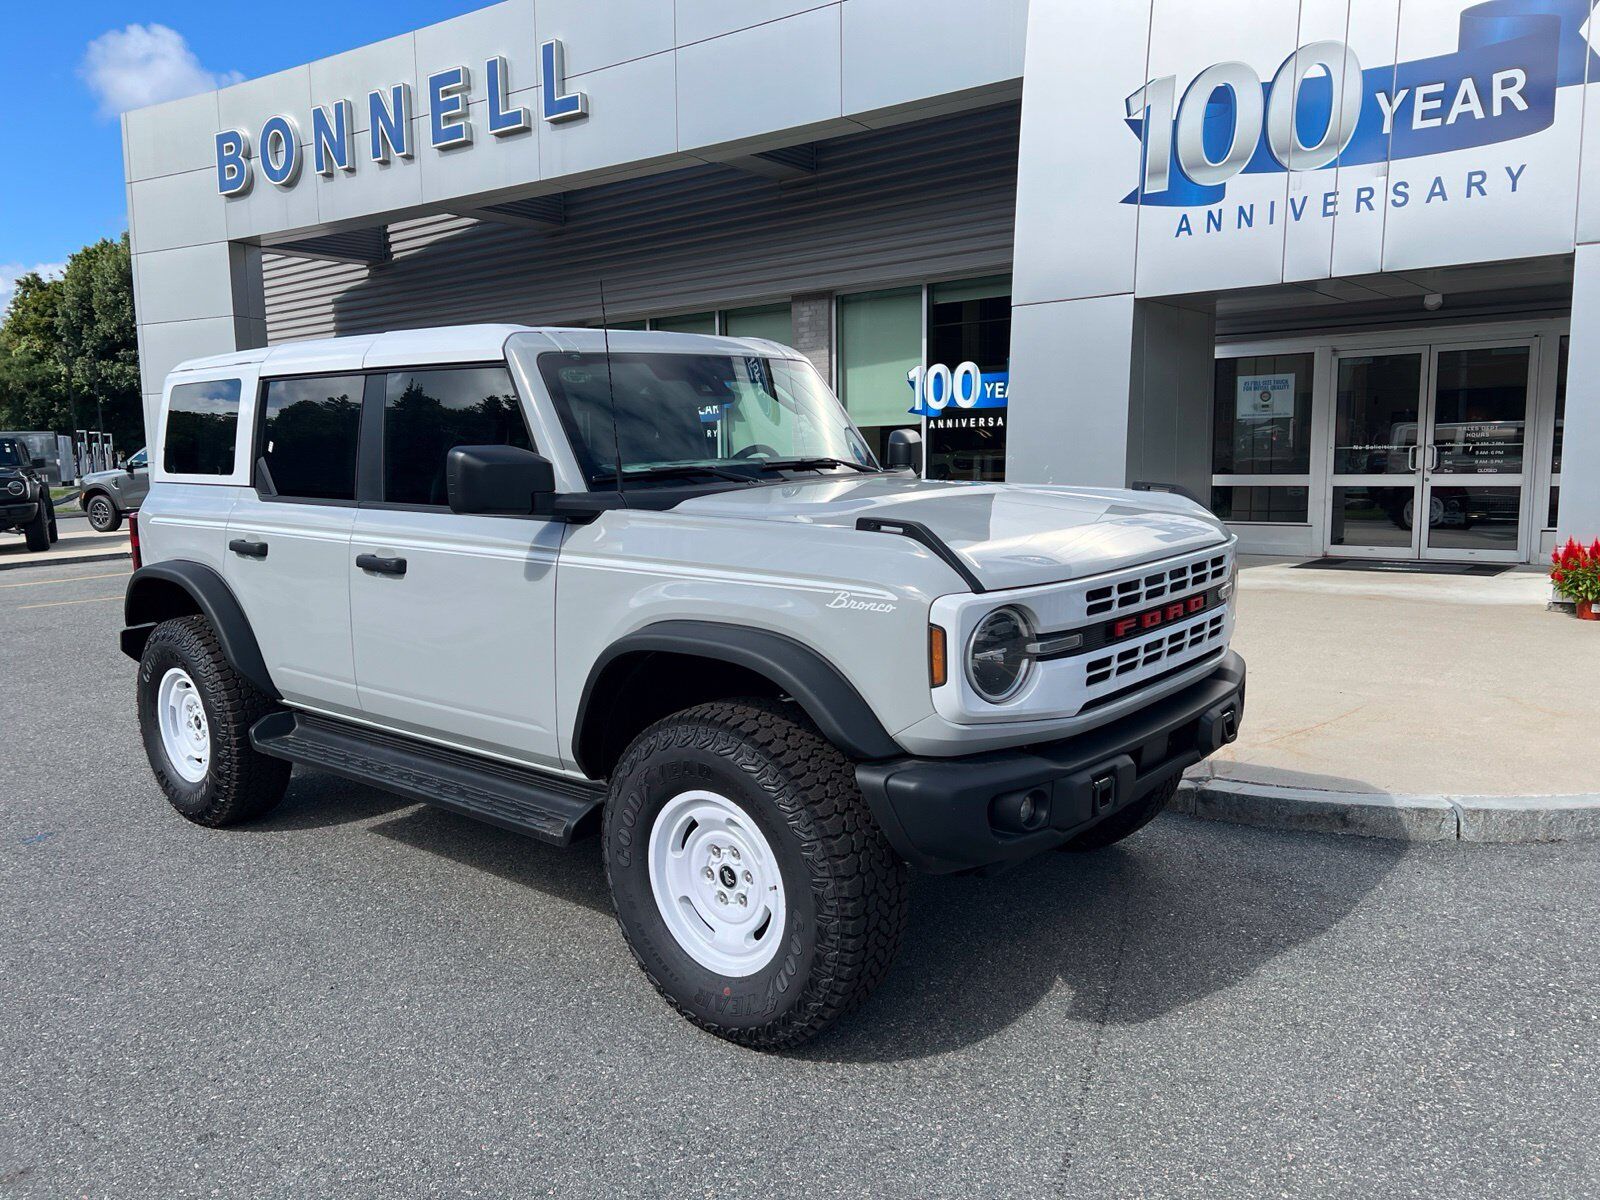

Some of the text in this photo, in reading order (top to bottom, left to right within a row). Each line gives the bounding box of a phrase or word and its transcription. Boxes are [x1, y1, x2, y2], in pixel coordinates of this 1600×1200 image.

[213, 38, 588, 196] BONNELL
[1125, 39, 1530, 195] 100 YEAR
[1174, 163, 1527, 238] ANNIVERSARY
[906, 361, 1009, 411] 100 YE
[928, 416, 1004, 429] ANNIVERSA
[825, 590, 897, 613] Bronco
[1115, 595, 1204, 637] FORD
